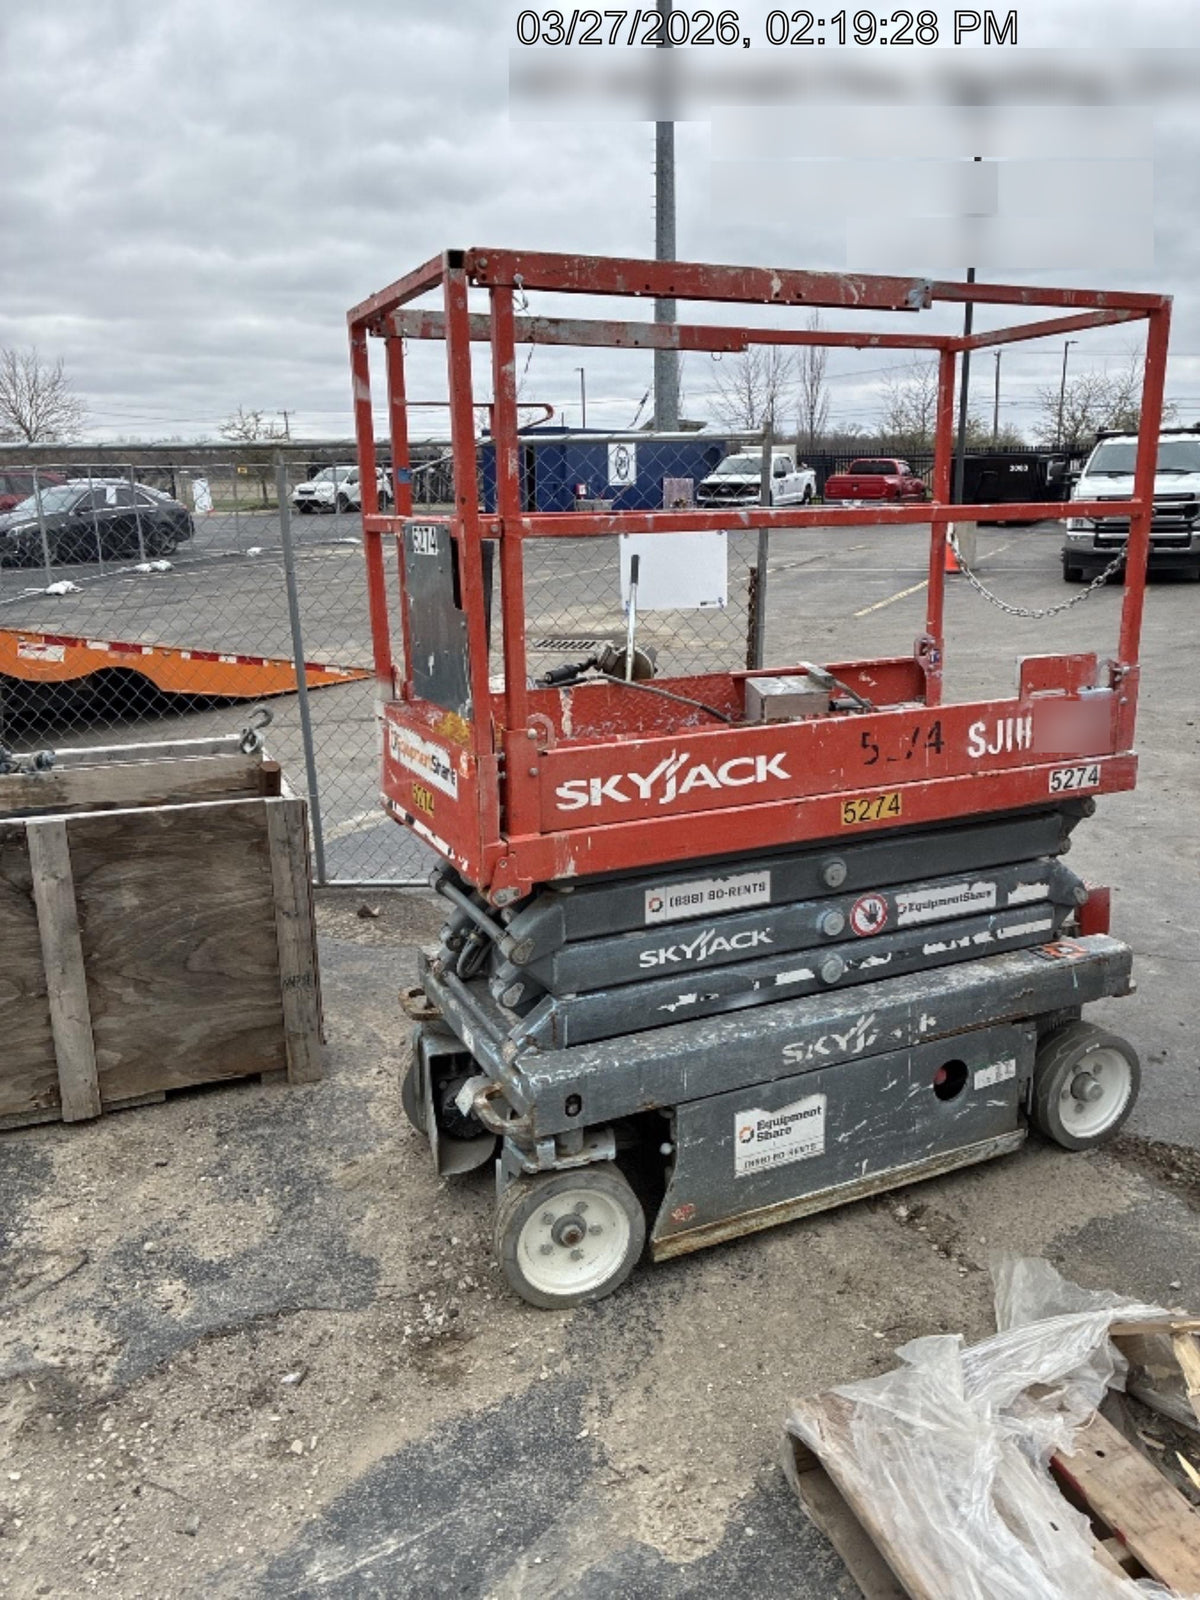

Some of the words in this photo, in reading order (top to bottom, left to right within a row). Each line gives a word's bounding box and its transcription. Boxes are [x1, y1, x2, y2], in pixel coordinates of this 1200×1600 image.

[412, 527, 437, 554] 5274
[555, 748, 792, 811] SKYJACK
[1050, 765, 1100, 791] 5274
[843, 794, 901, 824] 5274
[639, 927, 774, 968] SKYJACK
[756, 1105, 822, 1131] Equipment
[756, 1126, 792, 1142] Share
